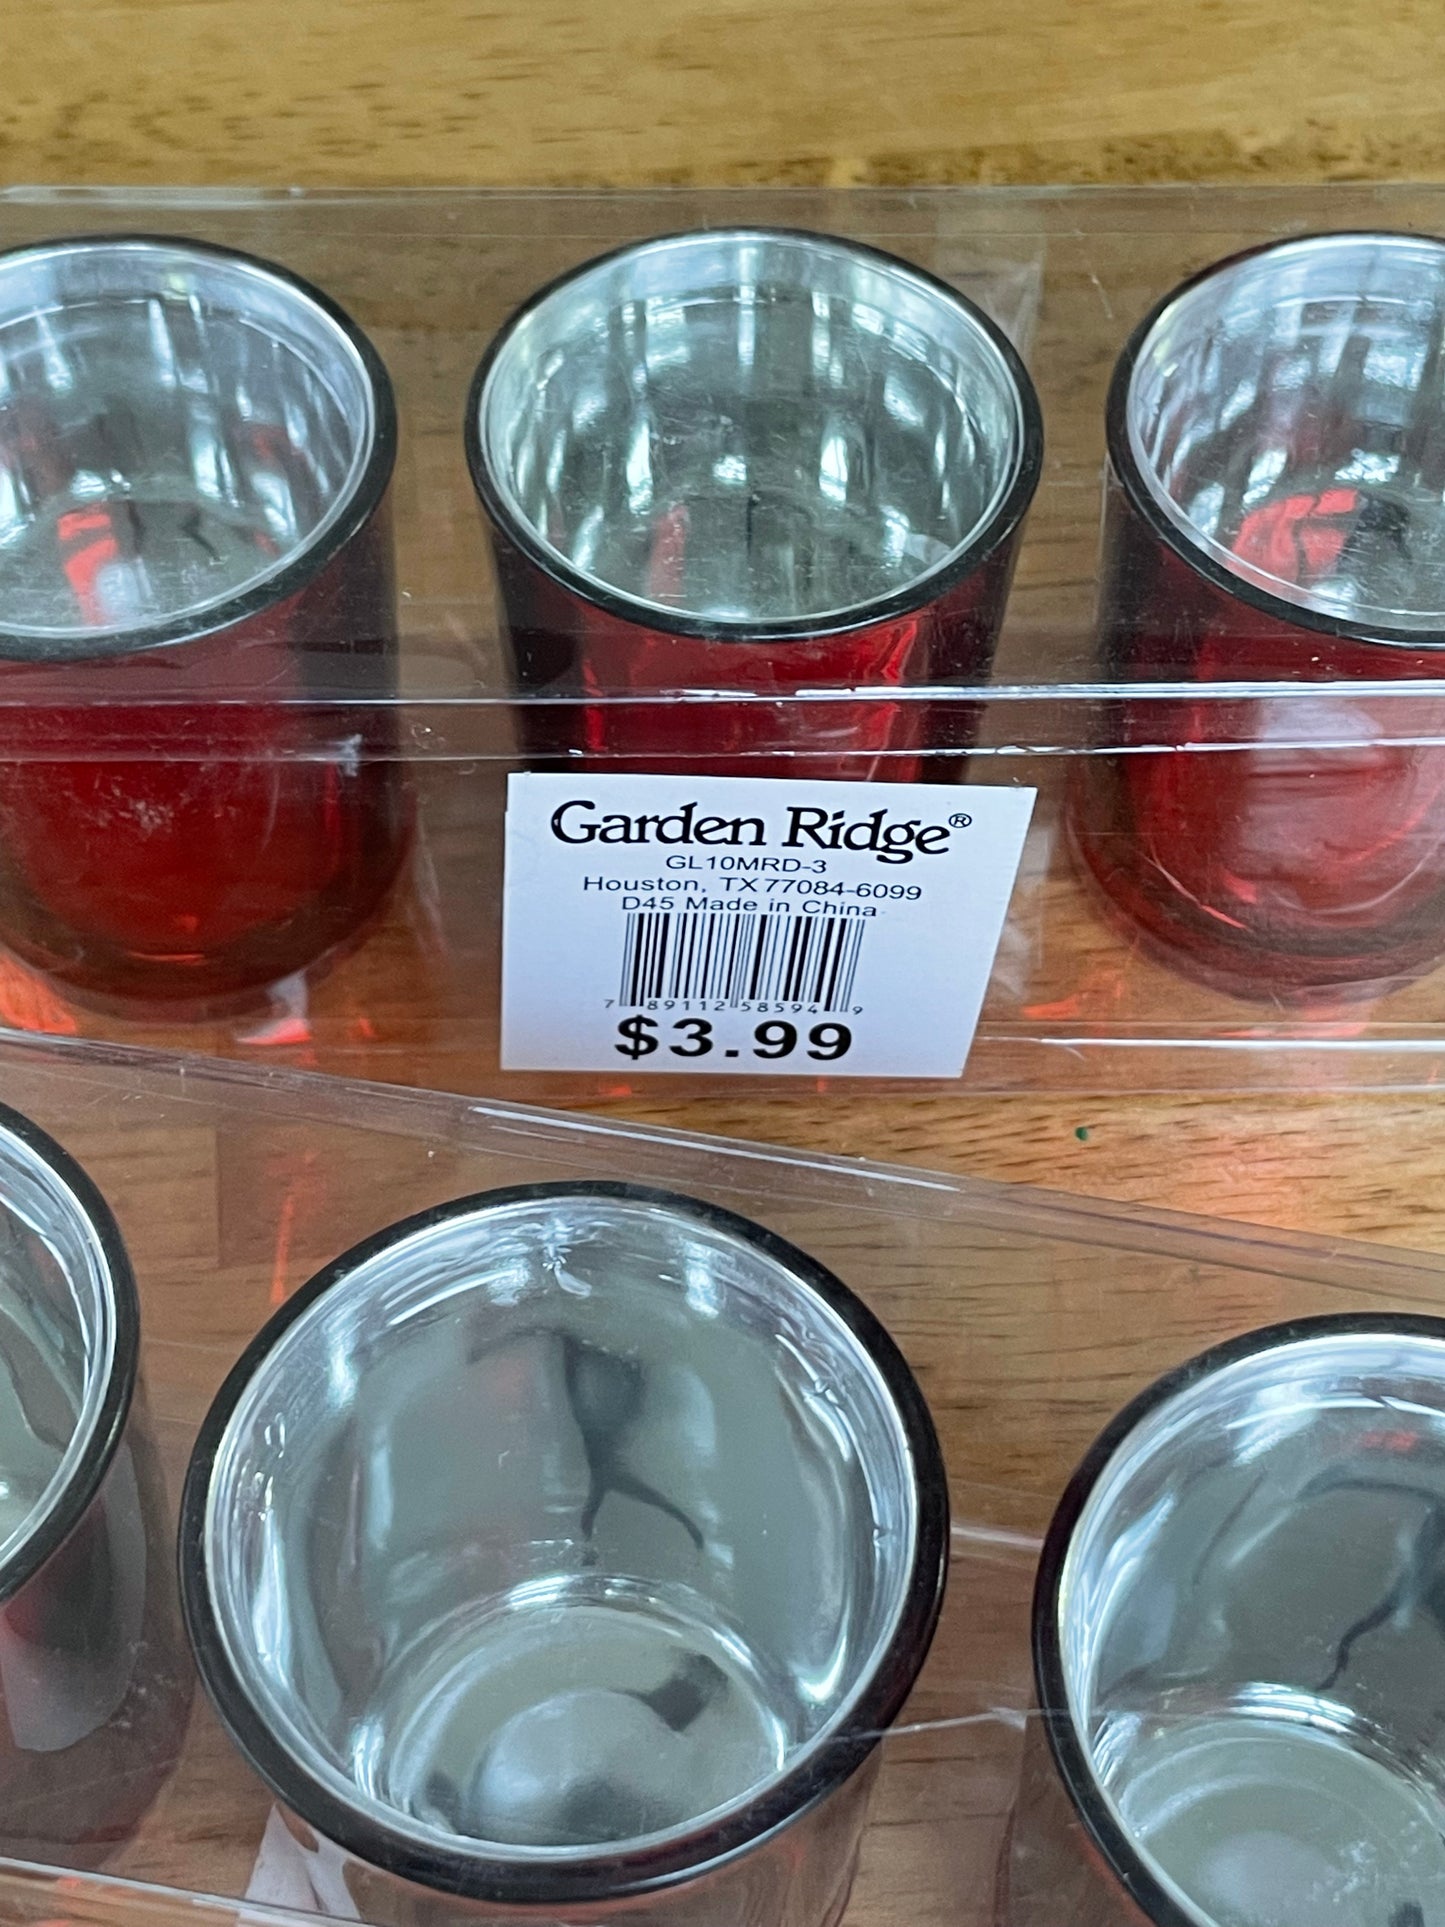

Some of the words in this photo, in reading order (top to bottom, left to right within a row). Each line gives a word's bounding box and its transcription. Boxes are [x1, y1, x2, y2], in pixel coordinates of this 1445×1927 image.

[550, 799, 766, 846] Garden
[665, 855, 828, 874] GL10MRD-3
[583, 876, 707, 894] Houston,
[719, 877, 758, 893] TX
[764, 878, 922, 901] 77084-6099
[621, 896, 675, 911] D45
[686, 897, 758, 913] Made
[768, 898, 790, 914] in
[802, 899, 878, 918] China
[614, 1014, 853, 1061] $3.99
